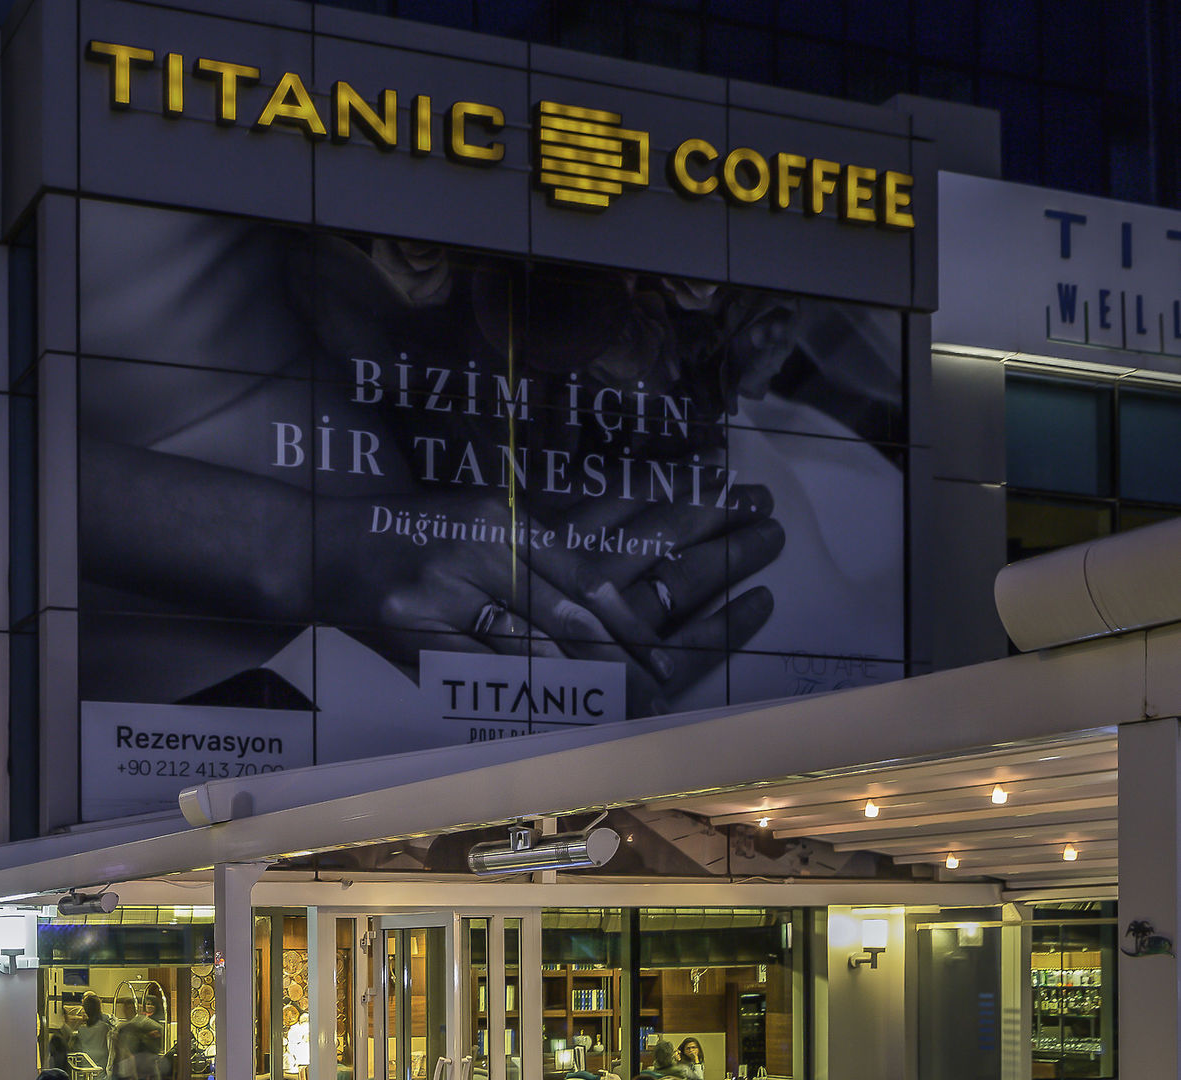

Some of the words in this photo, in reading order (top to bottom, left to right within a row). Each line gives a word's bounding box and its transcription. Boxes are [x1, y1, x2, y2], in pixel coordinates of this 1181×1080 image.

[86, 39, 506, 162] TITANIC
[671, 137, 915, 229] COFFEE
[351, 352, 534, 422] BİZİM
[565, 372, 691, 443] İÇİN
[271, 415, 385, 476] BİR
[414, 436, 759, 513] TANESİNİZ.
[567, 523, 683, 561] bekleriz.
[442, 679, 605, 717] TITANIC
[116, 725, 283, 758] Rezervasyon
[118, 759, 152, 777] +90
[156, 760, 190, 777] 212
[195, 761, 230, 779] 413
